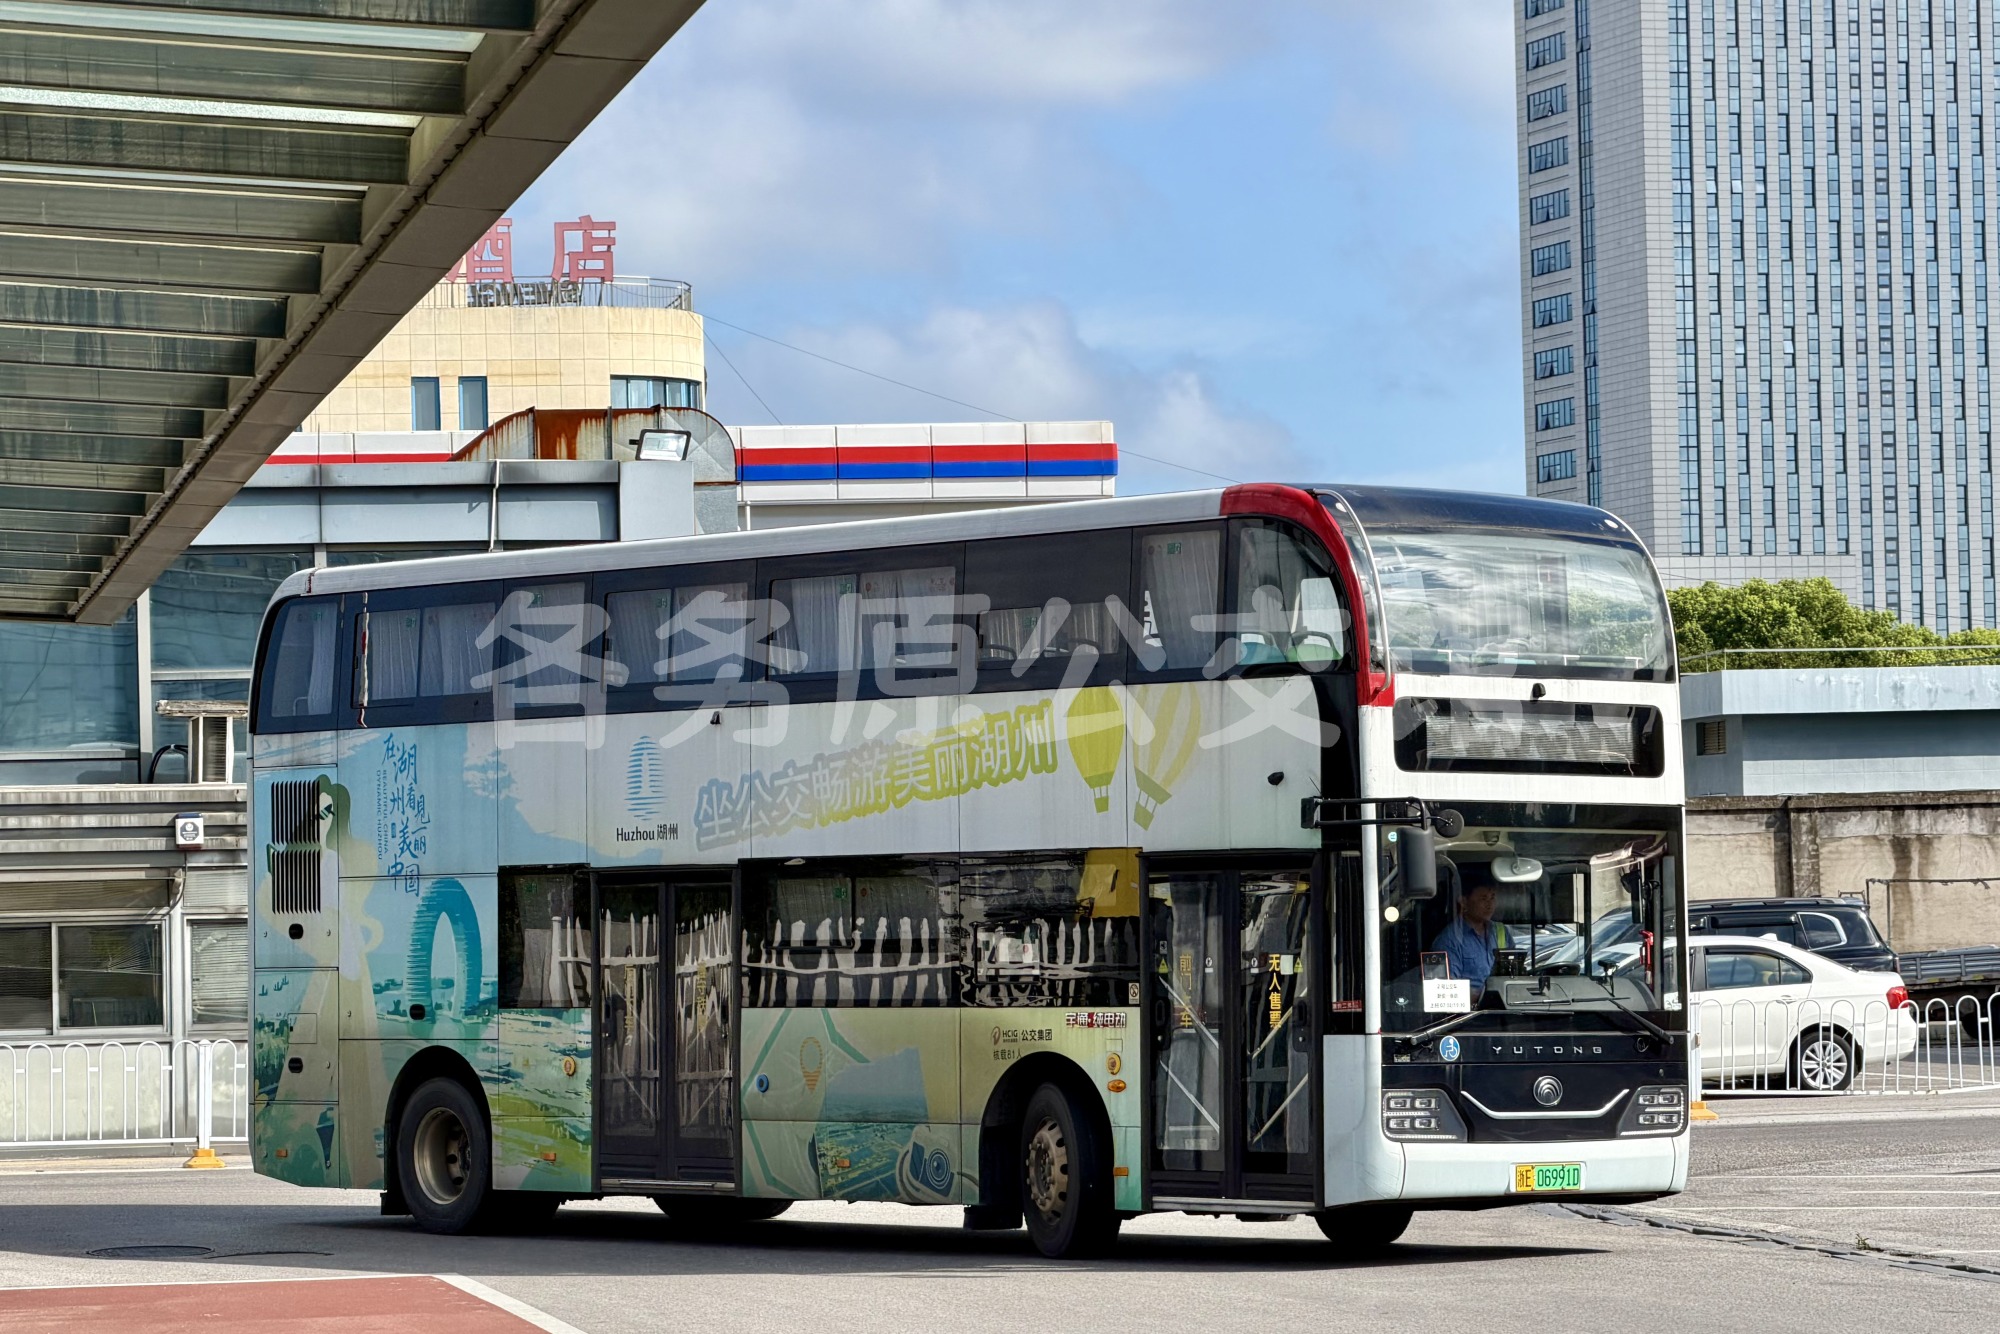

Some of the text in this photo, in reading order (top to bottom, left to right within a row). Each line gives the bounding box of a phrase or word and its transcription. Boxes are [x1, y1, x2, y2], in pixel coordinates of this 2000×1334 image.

[697, 701, 1057, 845] 坐公交畅游美丽湖州
[616, 823, 678, 841] Huzhou 湖州
[1268, 953, 1282, 1028] 无人售票
[1021, 1028, 1053, 1041] 公交集团
[1491, 1045, 1603, 1055] YUTONG
